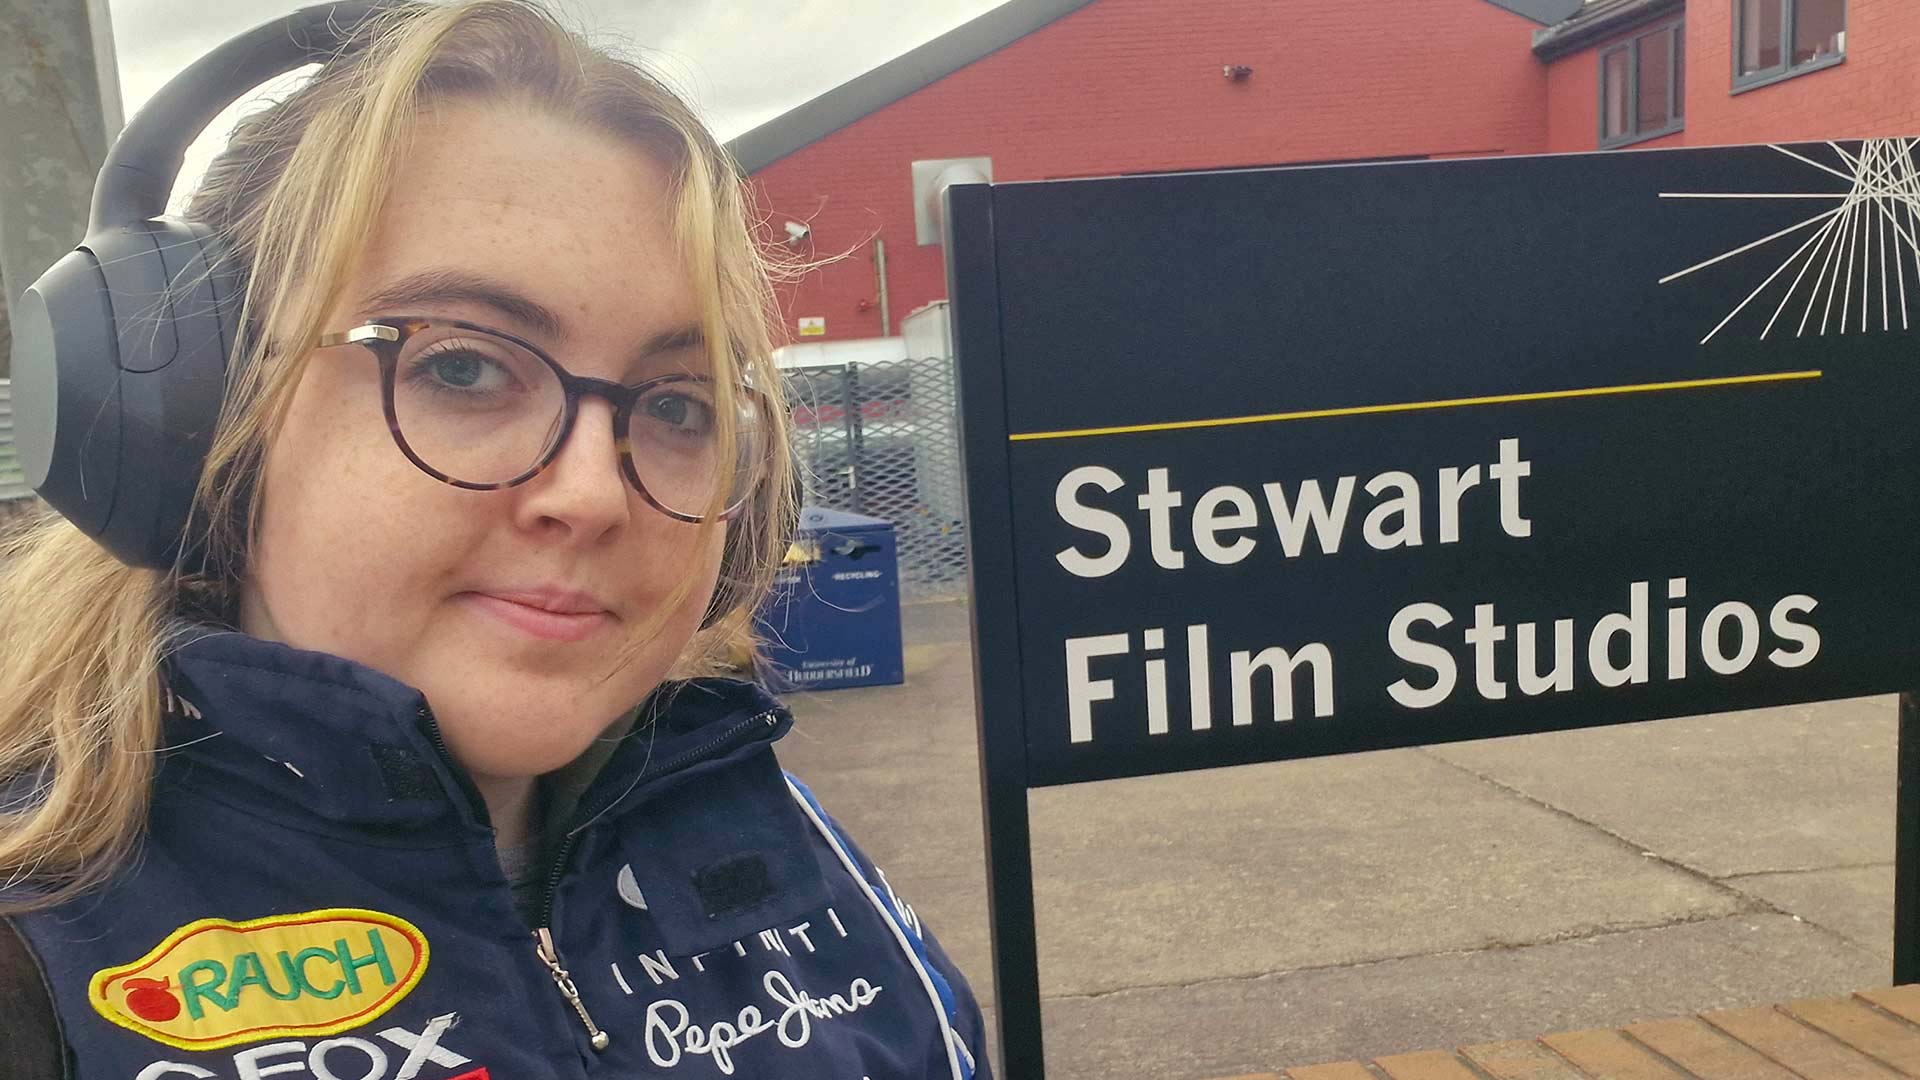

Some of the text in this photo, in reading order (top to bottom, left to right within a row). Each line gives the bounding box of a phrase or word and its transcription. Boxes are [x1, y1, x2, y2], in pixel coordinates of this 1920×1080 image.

[1055, 438, 1531, 578] Stewart
[834, 570, 881, 581] RECYCLING
[1065, 577, 1821, 744] Film Studios
[178, 927, 397, 1021] RAUCH
[645, 999, 775, 1075] Pepe
